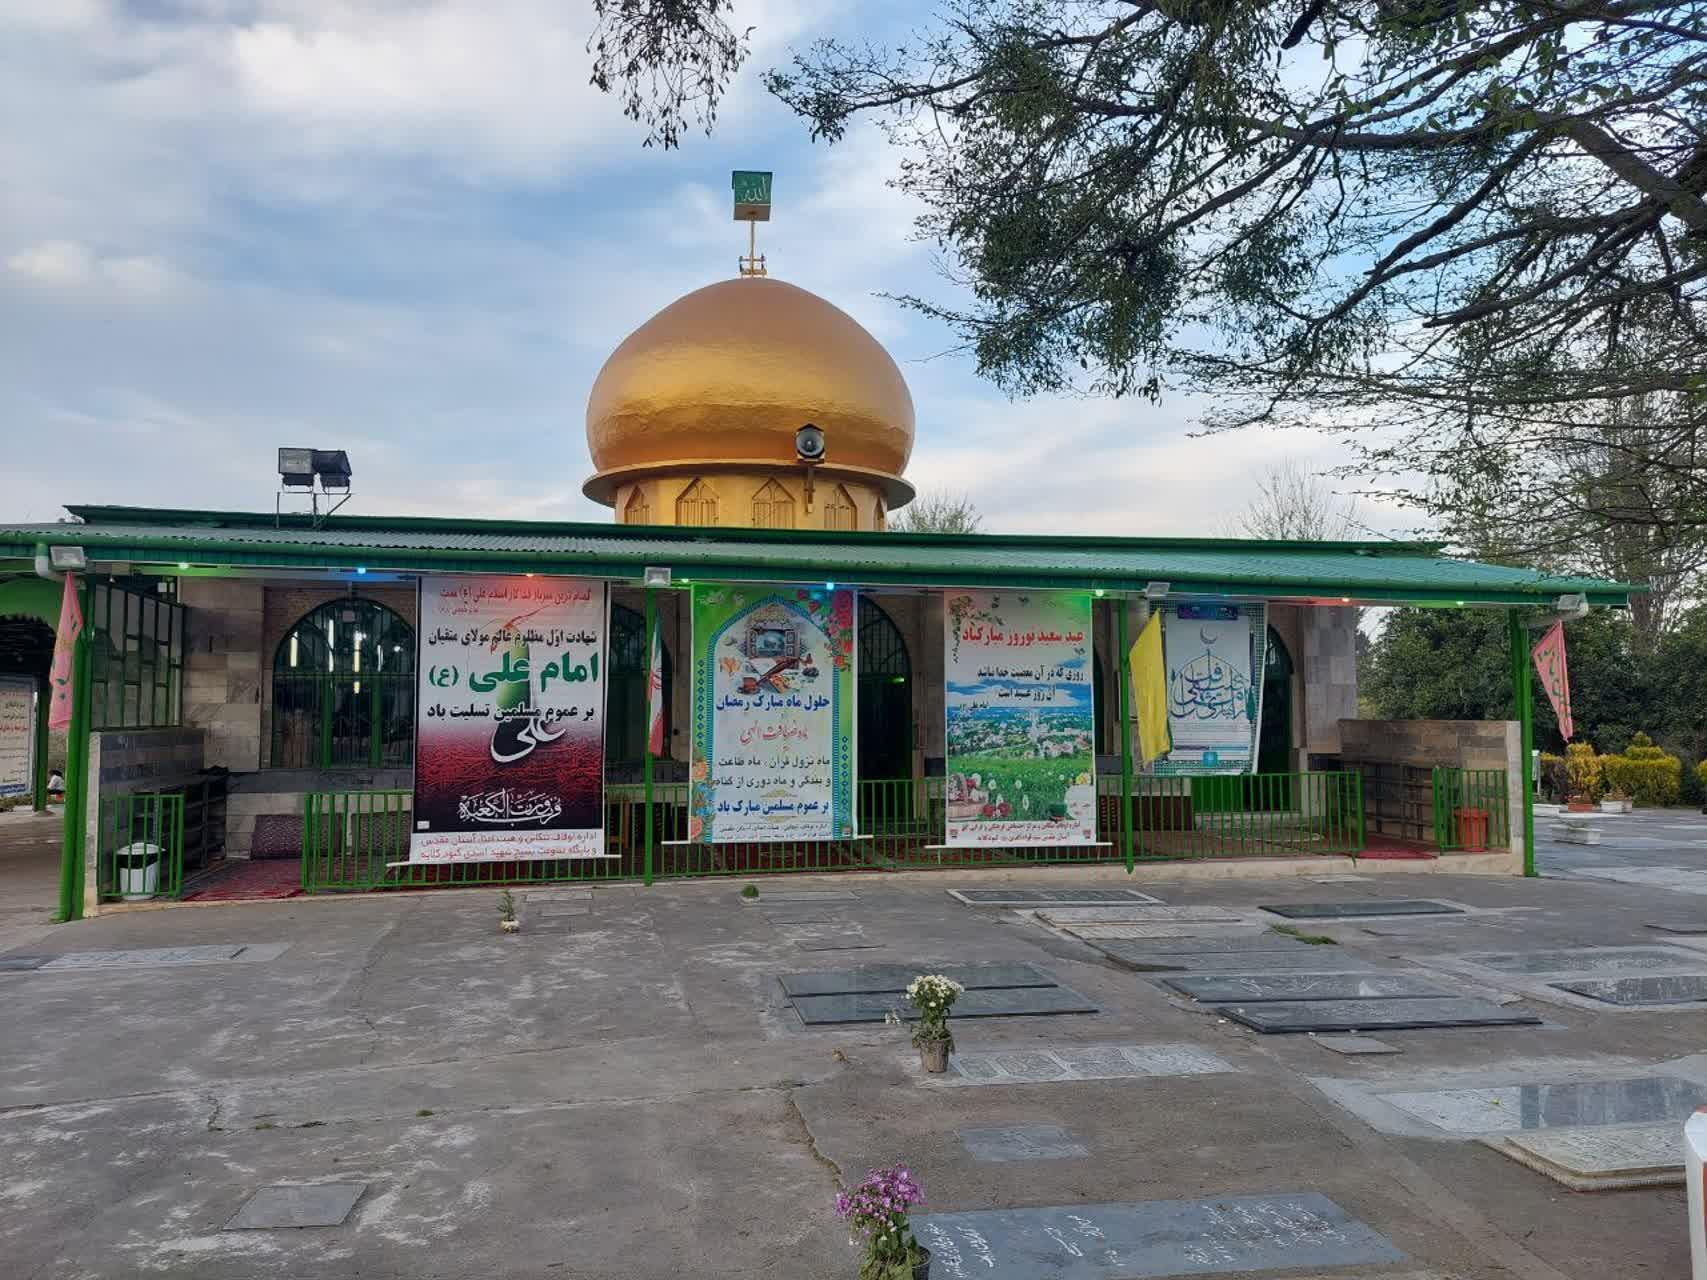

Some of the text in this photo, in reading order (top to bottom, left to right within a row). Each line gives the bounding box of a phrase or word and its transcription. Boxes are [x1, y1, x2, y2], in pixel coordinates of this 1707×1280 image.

[461, 627, 489, 646] مولای
[514, 628, 544, 648] مظلوم
[565, 630, 597, 646] شهادت
[1007, 630, 1035, 647] نوروز
[1038, 630, 1063, 645] سعید
[1065, 630, 1084, 644] عید
[429, 650, 599, 692] امام علی (ع)
[715, 694, 831, 711] حلول ماه مبارک رمضان
[427, 702, 594, 722] بر عموم مسلمین تسلیت باد
[747, 755, 761, 767] ماه
[791, 755, 815, 770] نزول
[817, 755, 830, 767] ماه
[773, 776, 787, 786] ماه
[790, 779, 797, 788] و
[717, 799, 829, 816] بر عموم مسلمین مبارک باد
